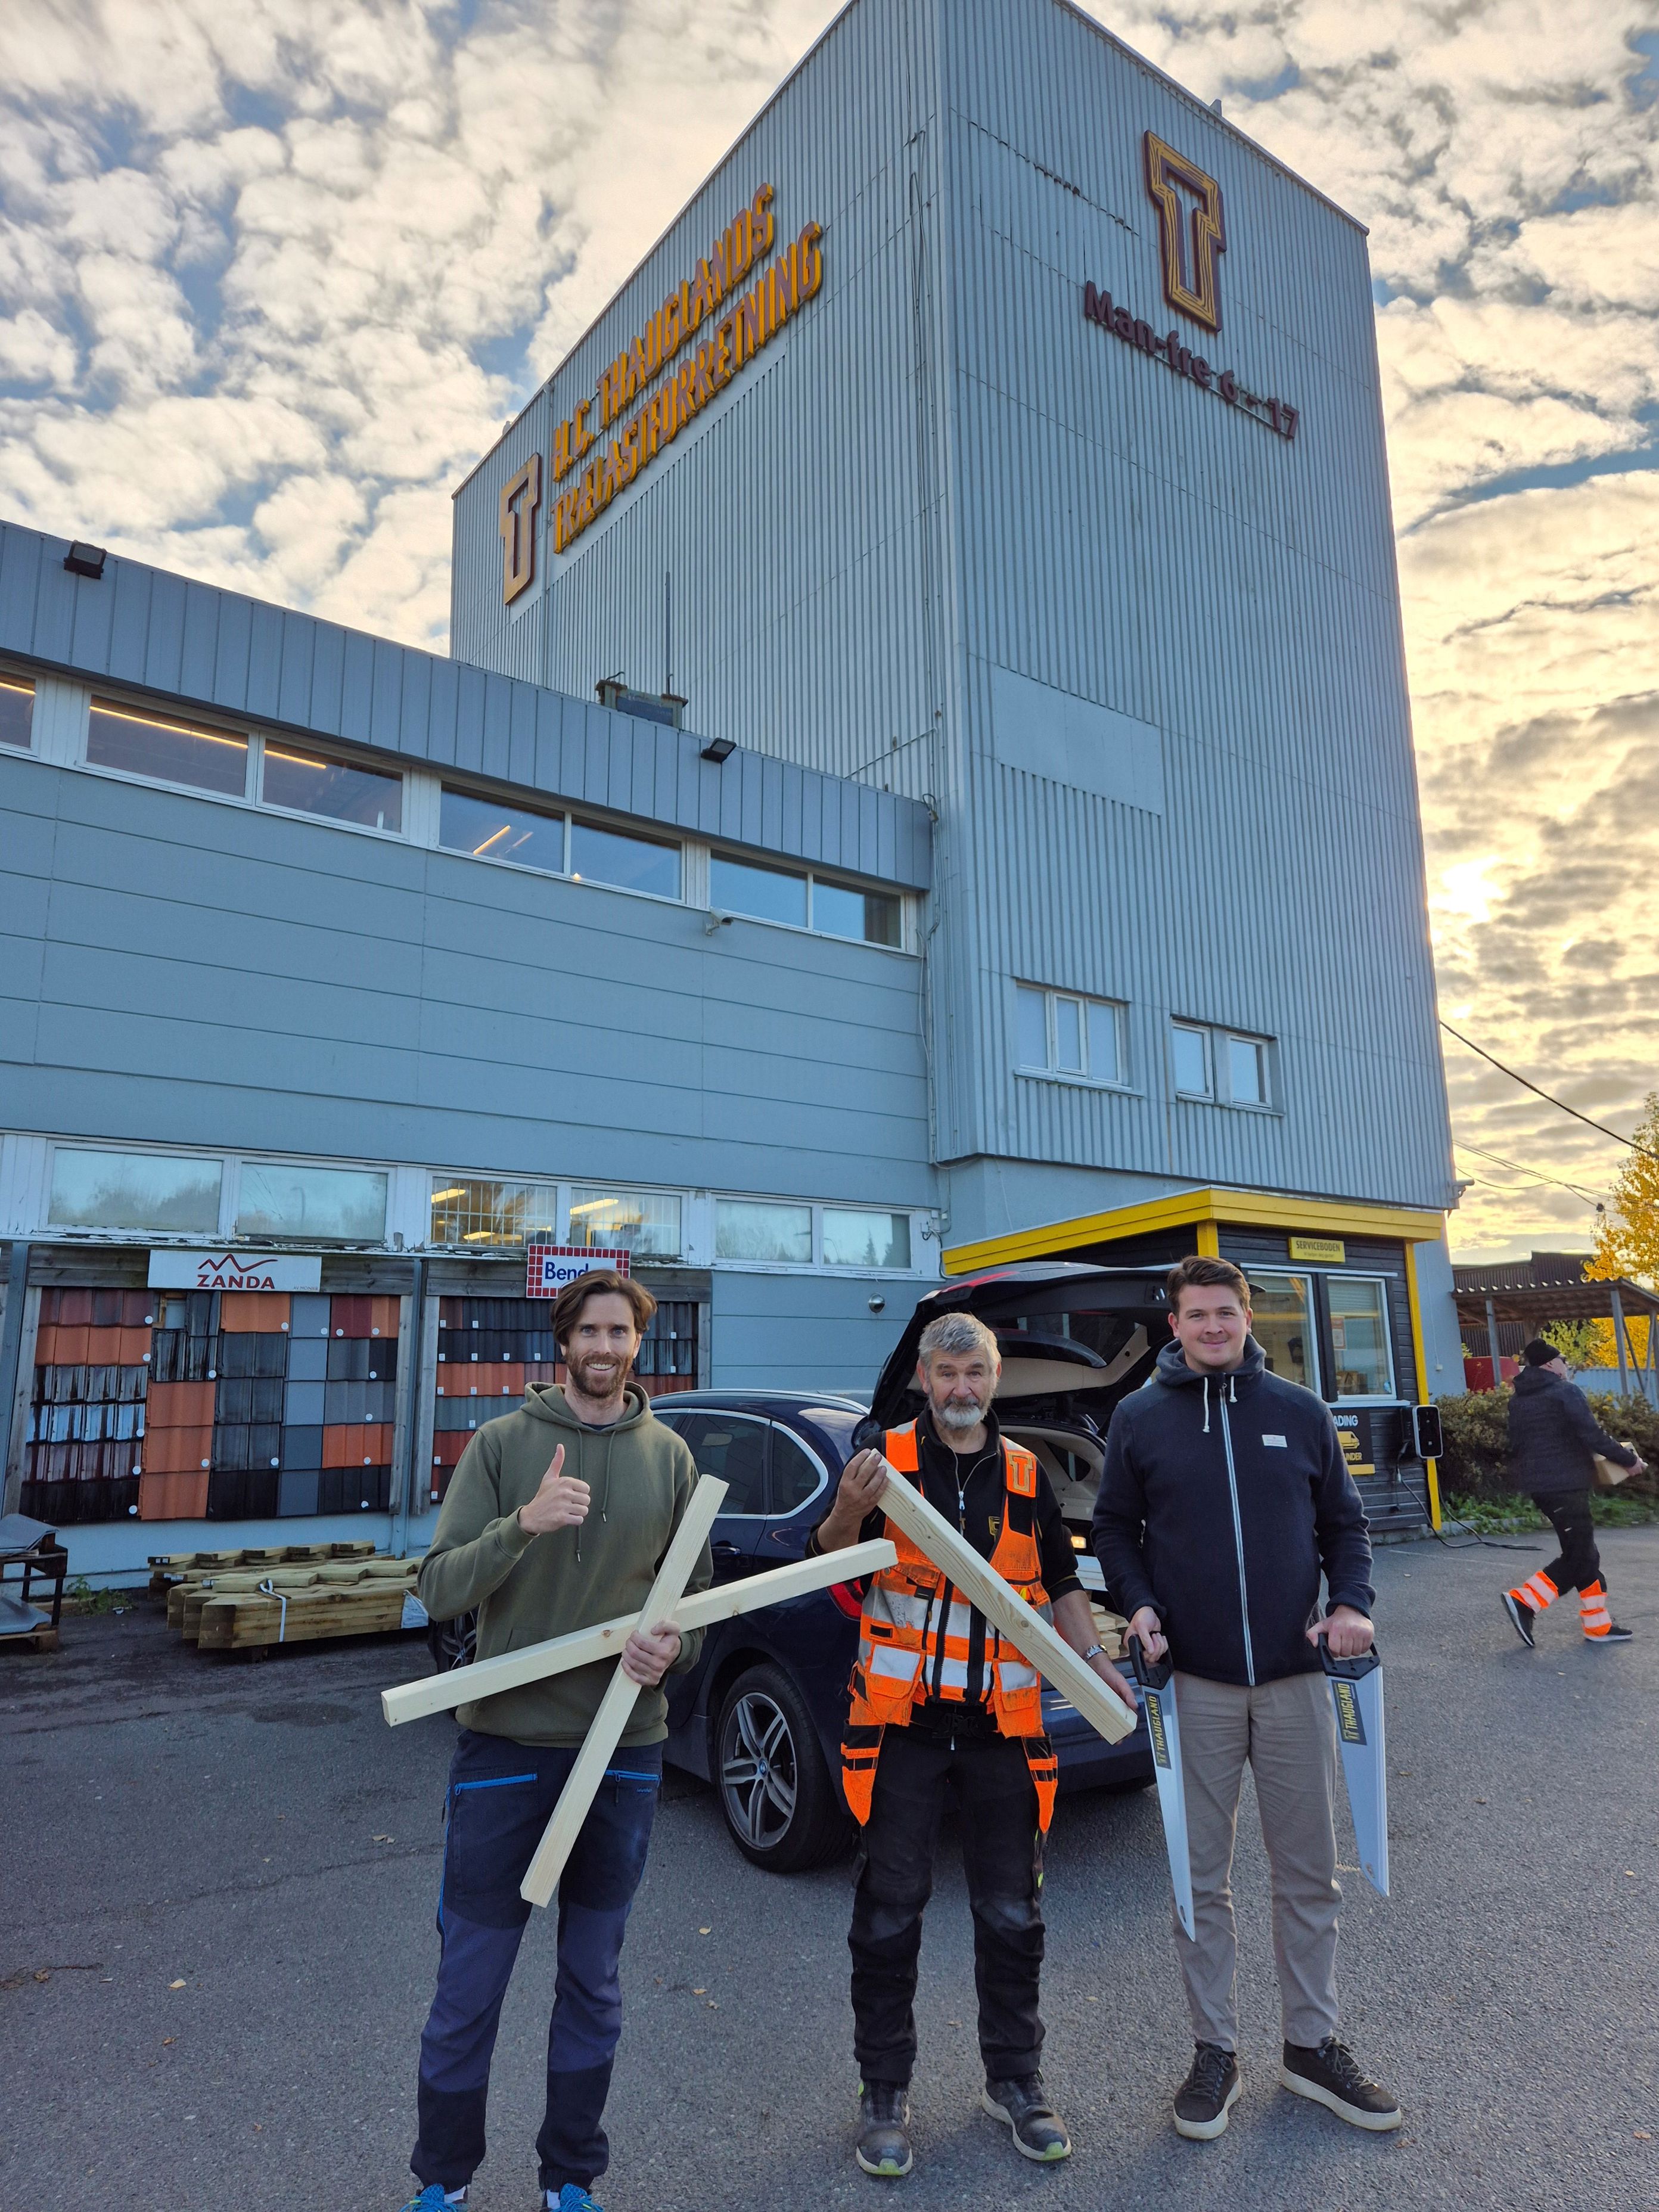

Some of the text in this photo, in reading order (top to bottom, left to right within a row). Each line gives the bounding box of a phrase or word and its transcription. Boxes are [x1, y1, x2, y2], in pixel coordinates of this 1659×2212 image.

[596, 182, 775, 431] THAUGLANDS
[1085, 279, 1211, 388] Man-fre
[551, 220, 824, 555] TRÆLASTFORRETNING
[1295, 1239, 1341, 1252] SERVICEBODEN
[197, 1274, 275, 1290] ZANDA
[545, 1261, 589, 1281] Bend
[1332, 1414, 1359, 1427] ADING
[1148, 1695, 1166, 1752] THAUGLAND
[1337, 1683, 1358, 1729] THAUGLAND
